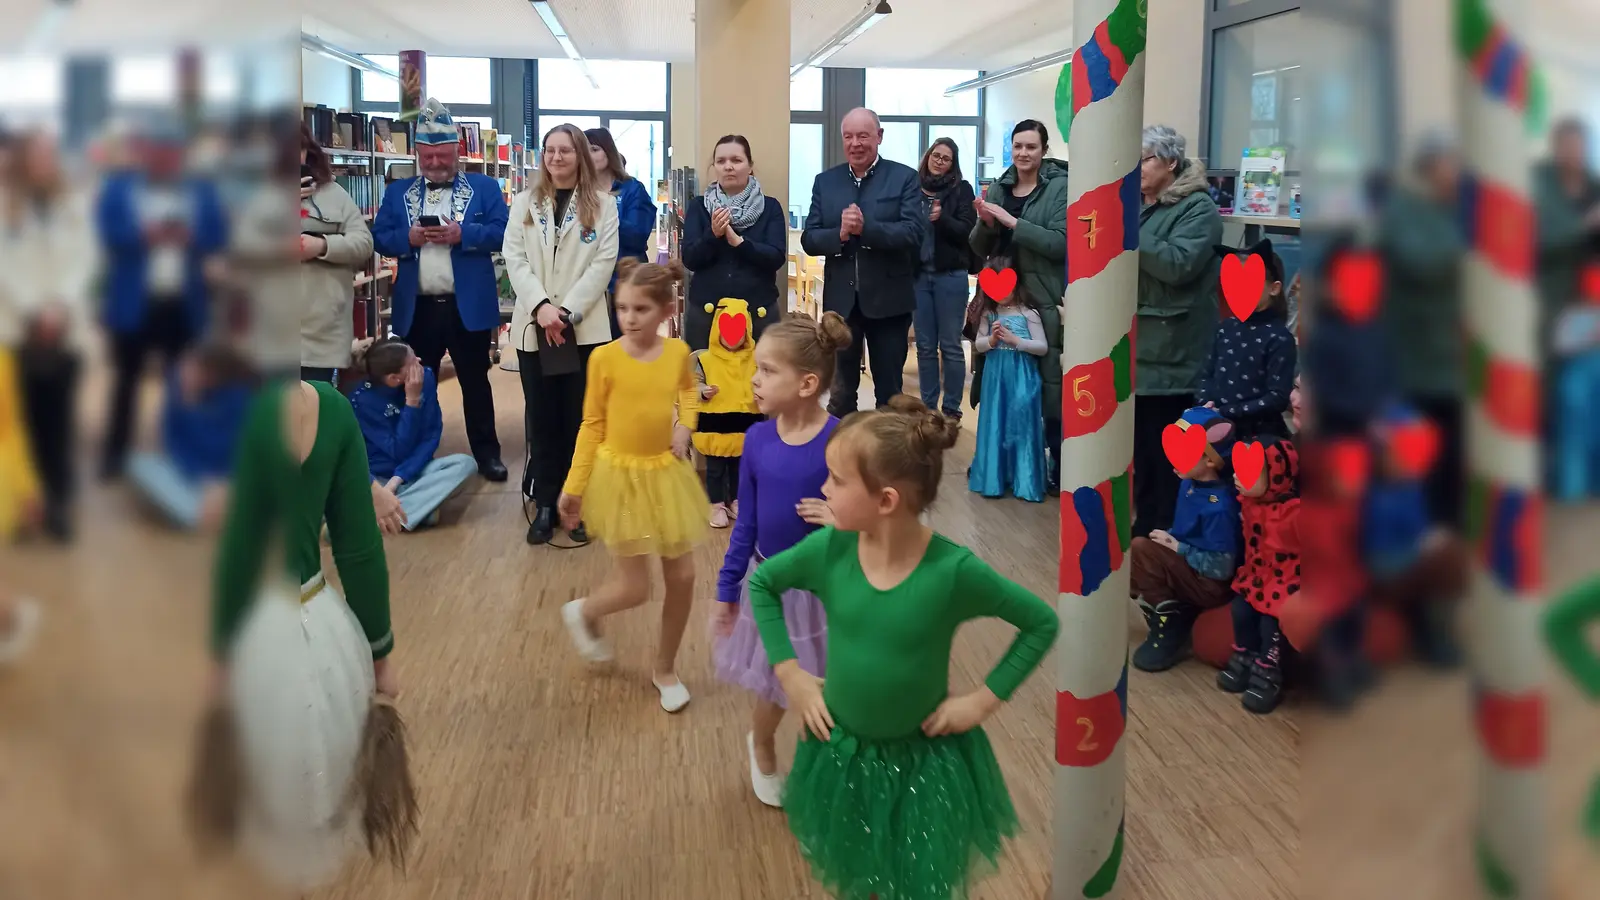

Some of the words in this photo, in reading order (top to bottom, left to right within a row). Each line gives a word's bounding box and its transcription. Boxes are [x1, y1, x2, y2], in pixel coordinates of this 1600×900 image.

[1078, 209, 1104, 249] 7
[1073, 374, 1096, 417] 5
[1076, 717, 1099, 751] 2
